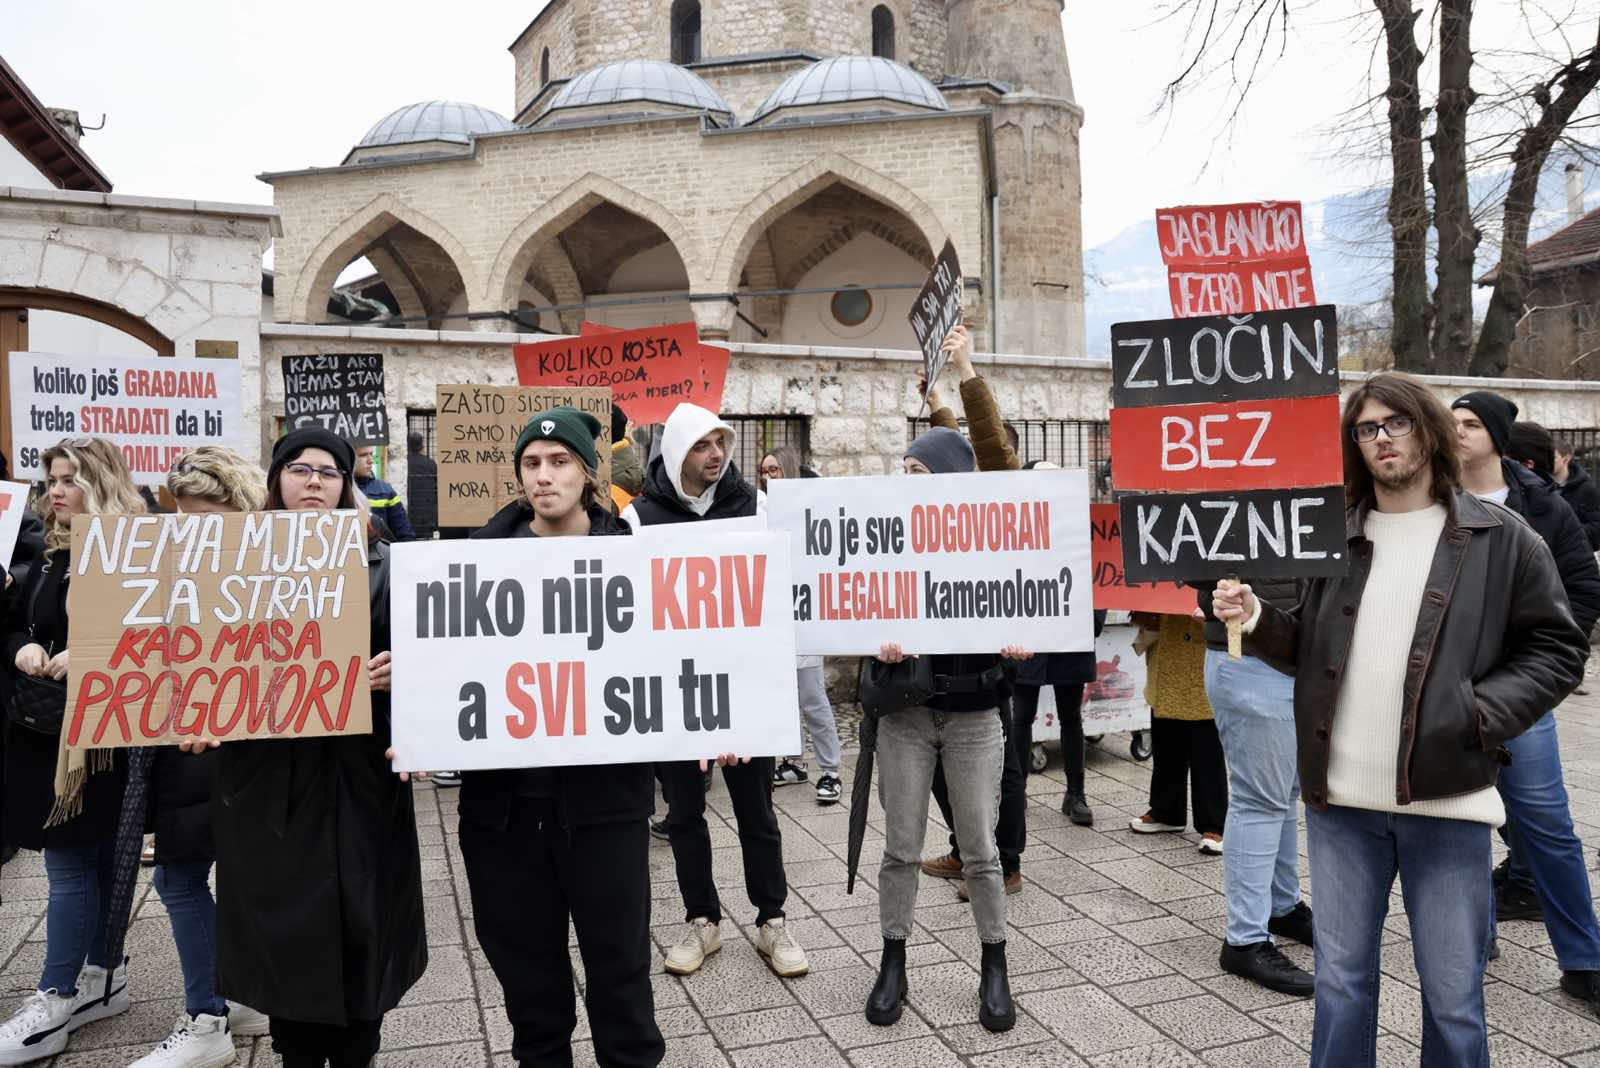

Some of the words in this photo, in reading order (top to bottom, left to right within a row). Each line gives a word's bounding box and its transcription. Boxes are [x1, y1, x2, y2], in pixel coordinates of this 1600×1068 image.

[1159, 200, 1300, 258] JABLANIČKO
[934, 261, 951, 296] TRI
[1170, 272, 1244, 317] JEZERO
[1252, 267, 1312, 312] NIJE
[290, 354, 339, 374] KAŽU
[347, 356, 377, 369] AKO
[539, 345, 613, 376] KOLIKO
[622, 338, 682, 362] KOŠTA
[1117, 313, 1335, 388] ZLOČIN.
[33, 366, 87, 396] koliko
[91, 368, 119, 401] još
[125, 369, 217, 399] GRAĐANA
[287, 395, 341, 415] ODMAH
[363, 390, 386, 408] GA
[347, 370, 384, 388] STAV
[441, 388, 505, 415] ZAŠTO
[518, 394, 573, 413] SISTEM
[580, 397, 610, 414] LOMI
[30, 405, 75, 432] treba
[80, 406, 169, 435] STRADATI
[176, 411, 198, 437] da
[205, 410, 223, 437] bi
[454, 424, 504, 441] SAMO
[1161, 411, 1276, 471] BEZ
[20, 446, 39, 468] se
[440, 449, 471, 463] ZAR
[476, 446, 506, 464] NAŠA
[449, 481, 490, 498] MORA
[78, 515, 224, 575] NEMA
[235, 510, 369, 572] MJESTA
[805, 508, 832, 556] ko
[838, 507, 859, 566] je
[866, 514, 904, 554] sve
[911, 501, 1050, 554] ODGOVORAN
[1137, 497, 1341, 565] KAZNE.
[121, 577, 200, 625] ZA
[214, 575, 346, 621] STRAH
[416, 563, 526, 639] niko
[542, 559, 635, 651] nije
[651, 554, 768, 631] KRIV
[818, 570, 918, 621] ILEGALNI
[924, 566, 1072, 619] kamenolom?
[109, 625, 202, 669] KAD
[210, 620, 322, 663] MASA
[67, 656, 361, 746] PROGOVORI
[457, 681, 488, 741] a
[505, 660, 587, 739] SVI
[603, 675, 664, 735] su
[678, 658, 731, 731] tu
